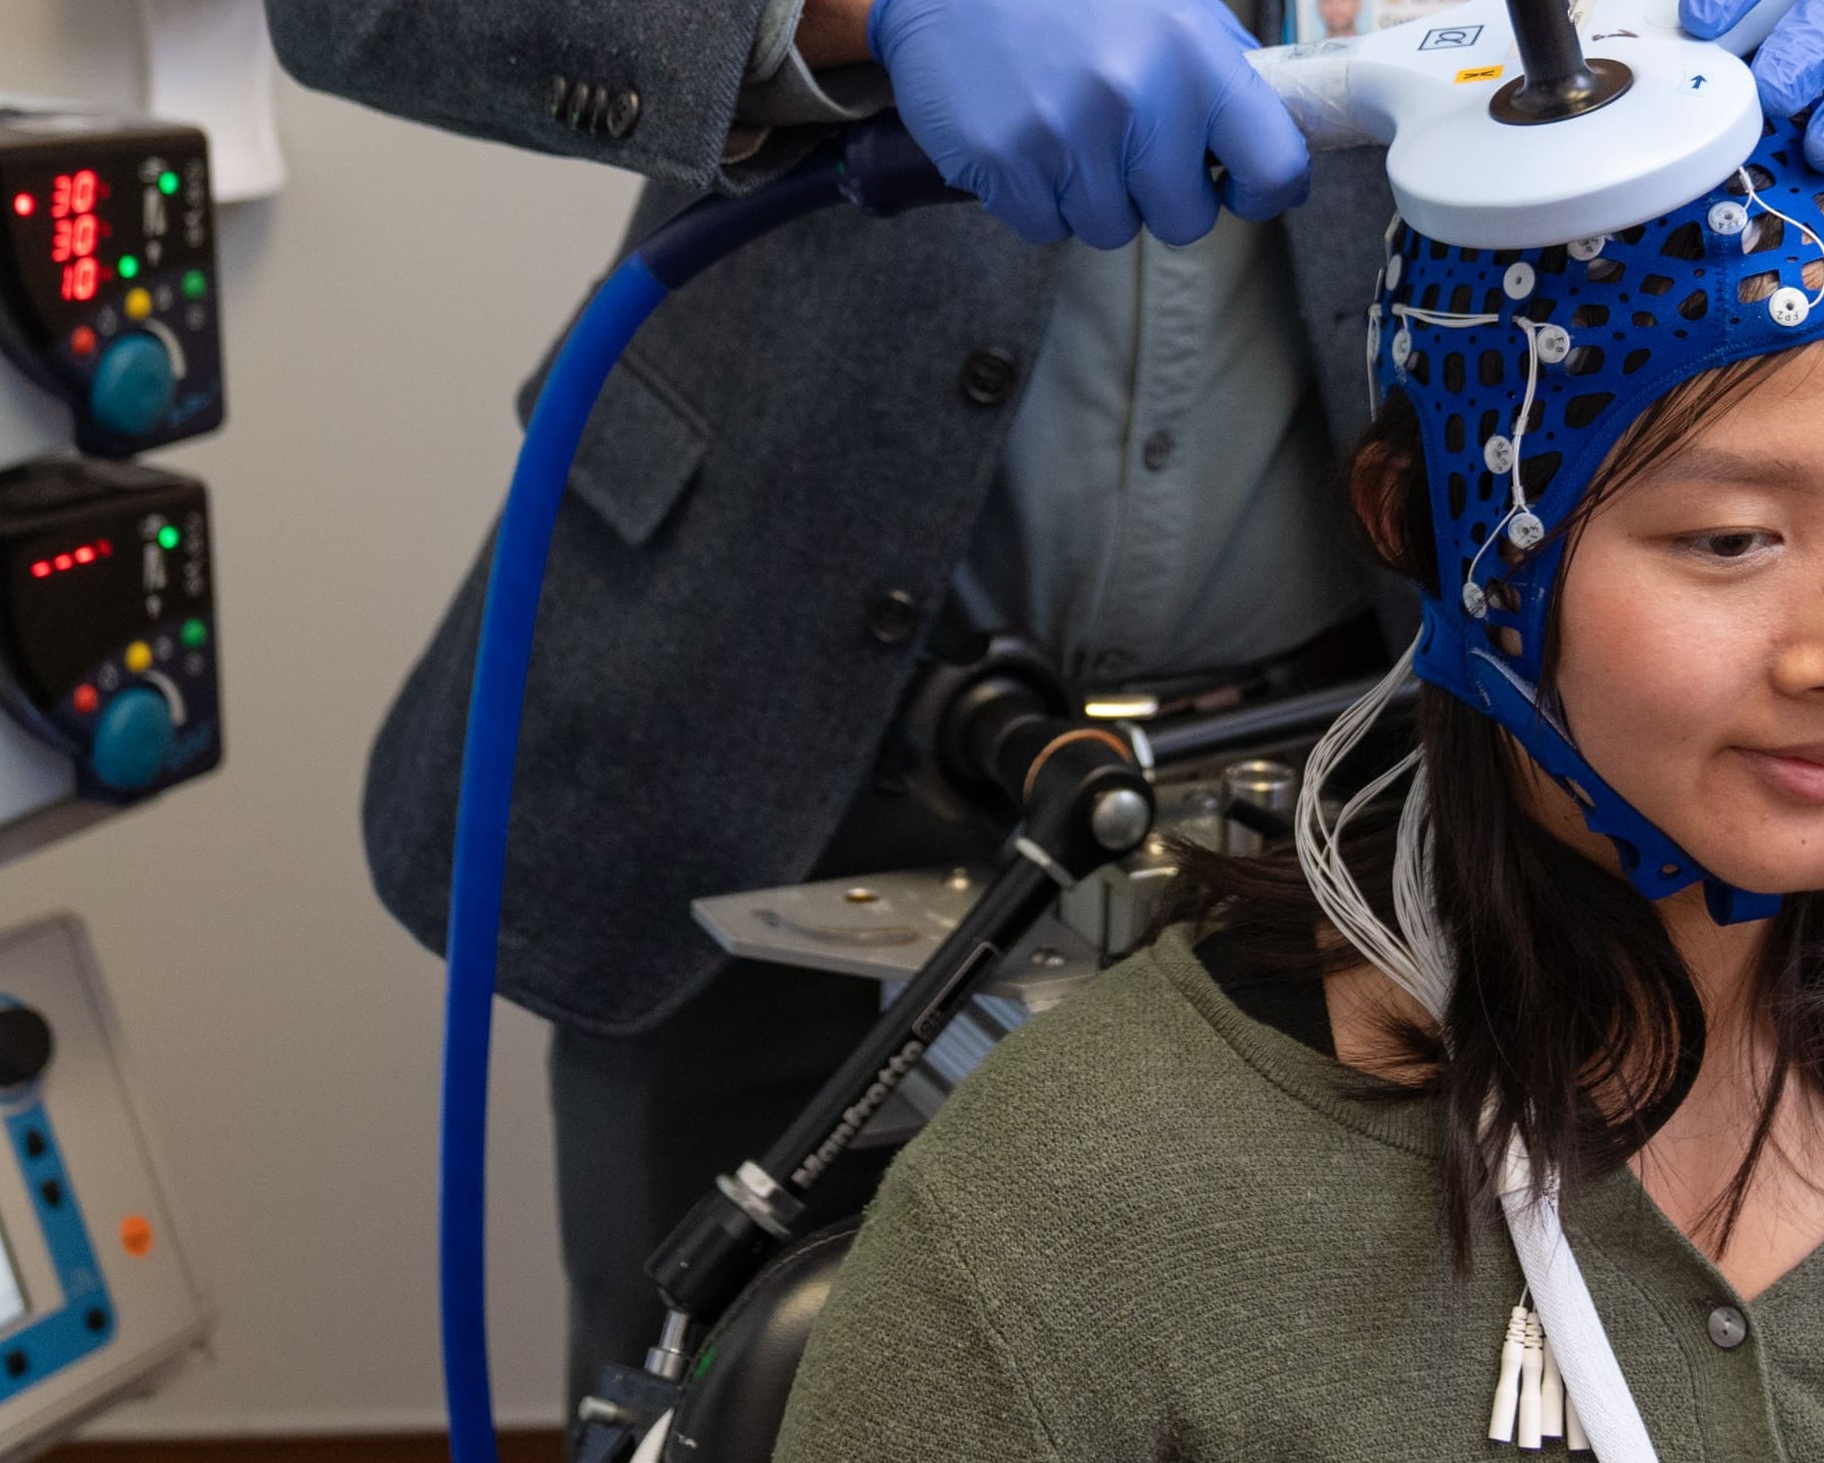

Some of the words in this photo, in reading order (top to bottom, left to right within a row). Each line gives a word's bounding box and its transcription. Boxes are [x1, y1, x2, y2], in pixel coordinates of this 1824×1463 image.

[51, 170, 97, 218] 30
[52, 214, 98, 262] 30
[61, 257, 98, 301] 10
[1776, 310, 1799, 322] FP2
